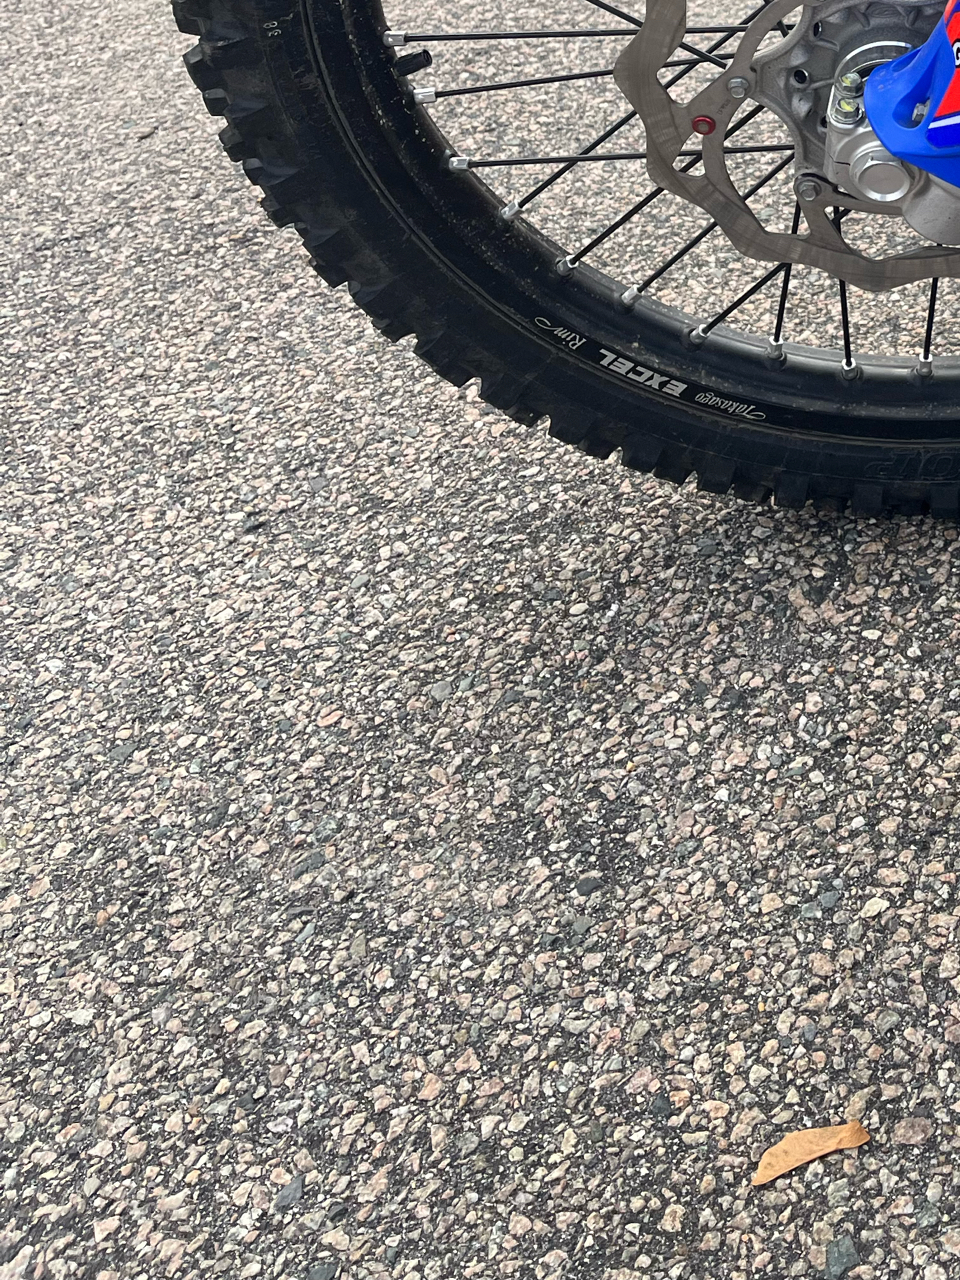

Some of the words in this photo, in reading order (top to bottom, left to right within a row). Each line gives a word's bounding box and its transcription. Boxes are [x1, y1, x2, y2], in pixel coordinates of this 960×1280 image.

[534, 316, 587, 350] Rim
[599, 348, 688, 397] EXCEL
[695, 391, 766, 420] Takasago
